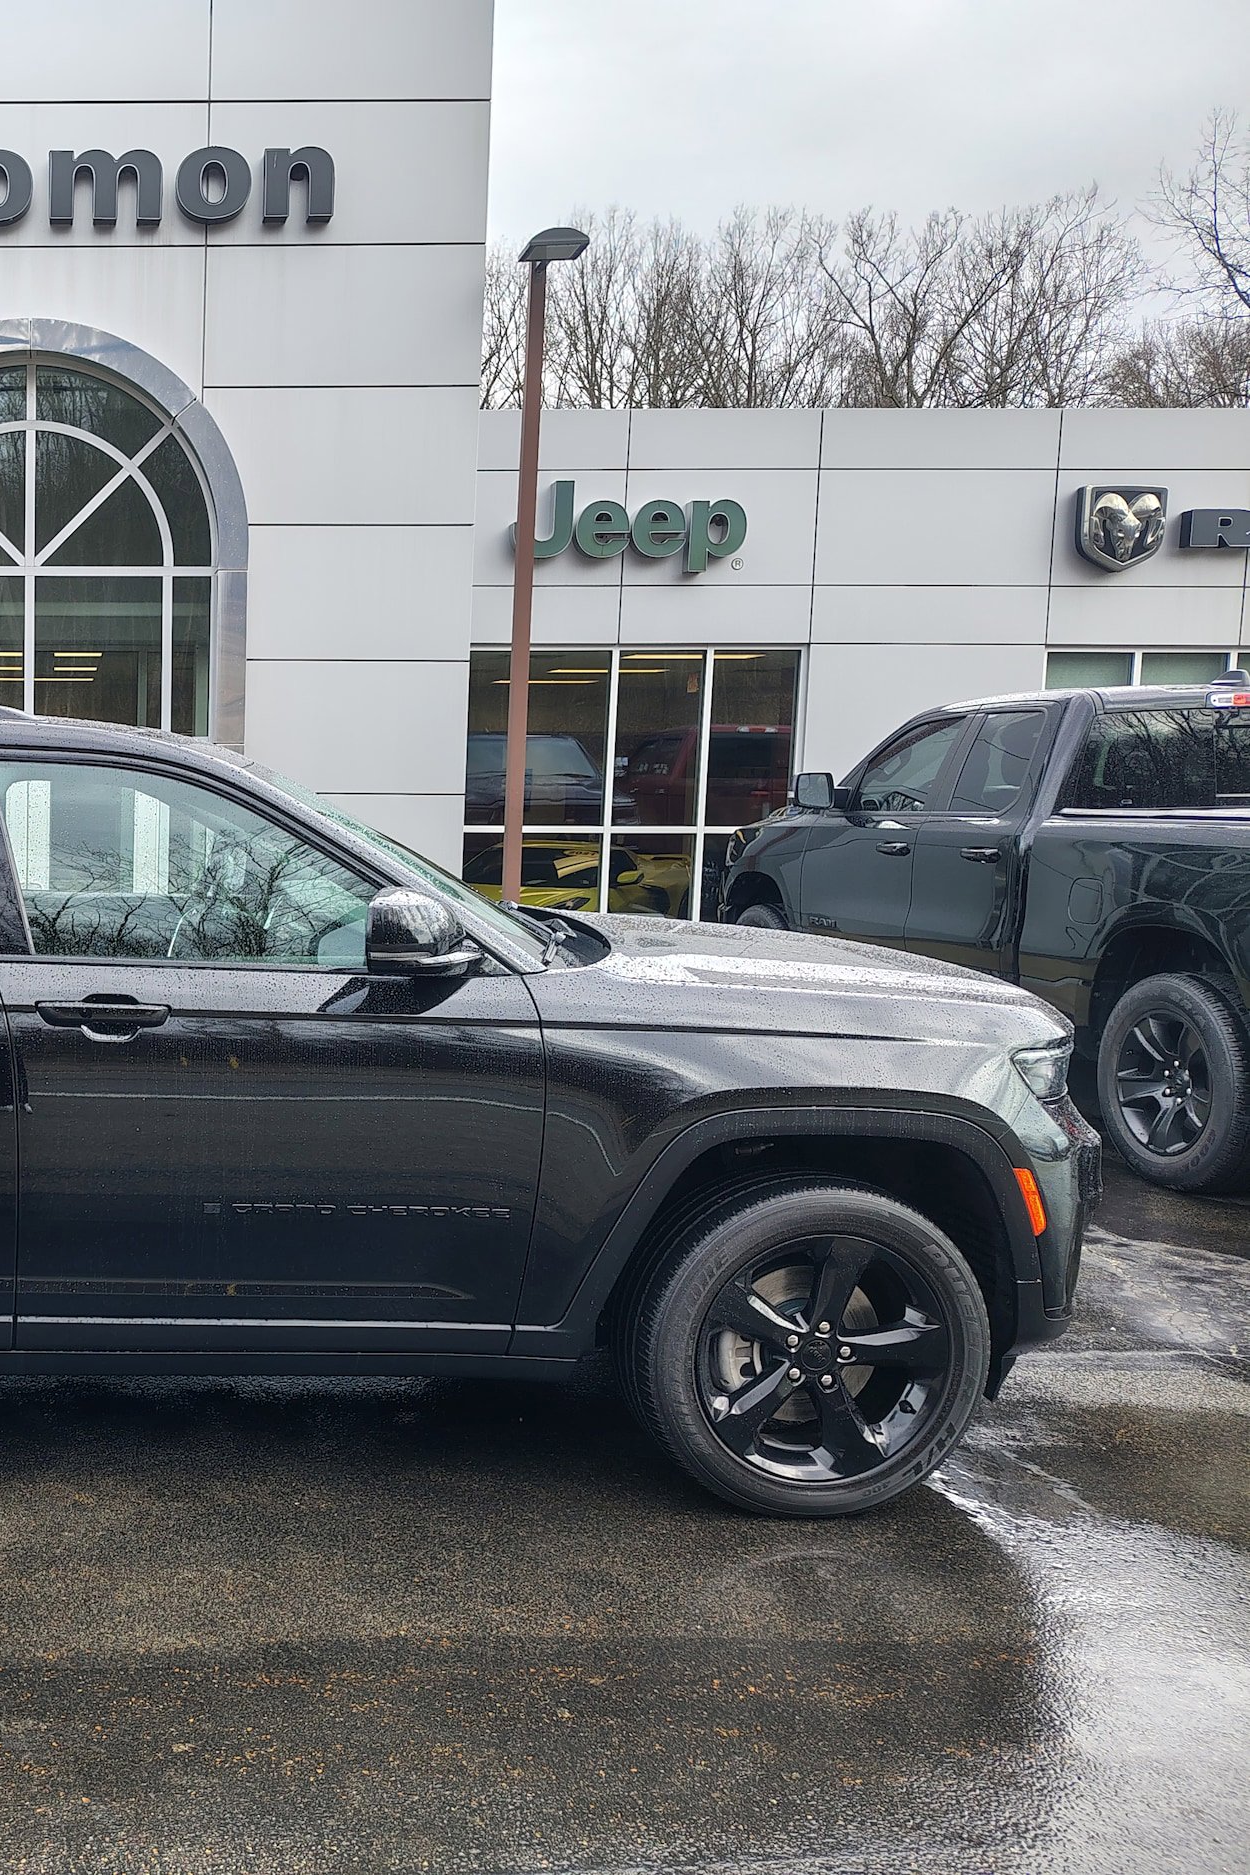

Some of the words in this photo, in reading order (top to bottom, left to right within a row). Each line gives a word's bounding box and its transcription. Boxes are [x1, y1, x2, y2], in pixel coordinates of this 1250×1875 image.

[509, 480, 748, 573] Jeep
[1178, 508, 1250, 548] R
[809, 916, 838, 928] RAM
[232, 1203, 337, 1215] GRAND
[346, 1204, 511, 1218] CHEROKEE
